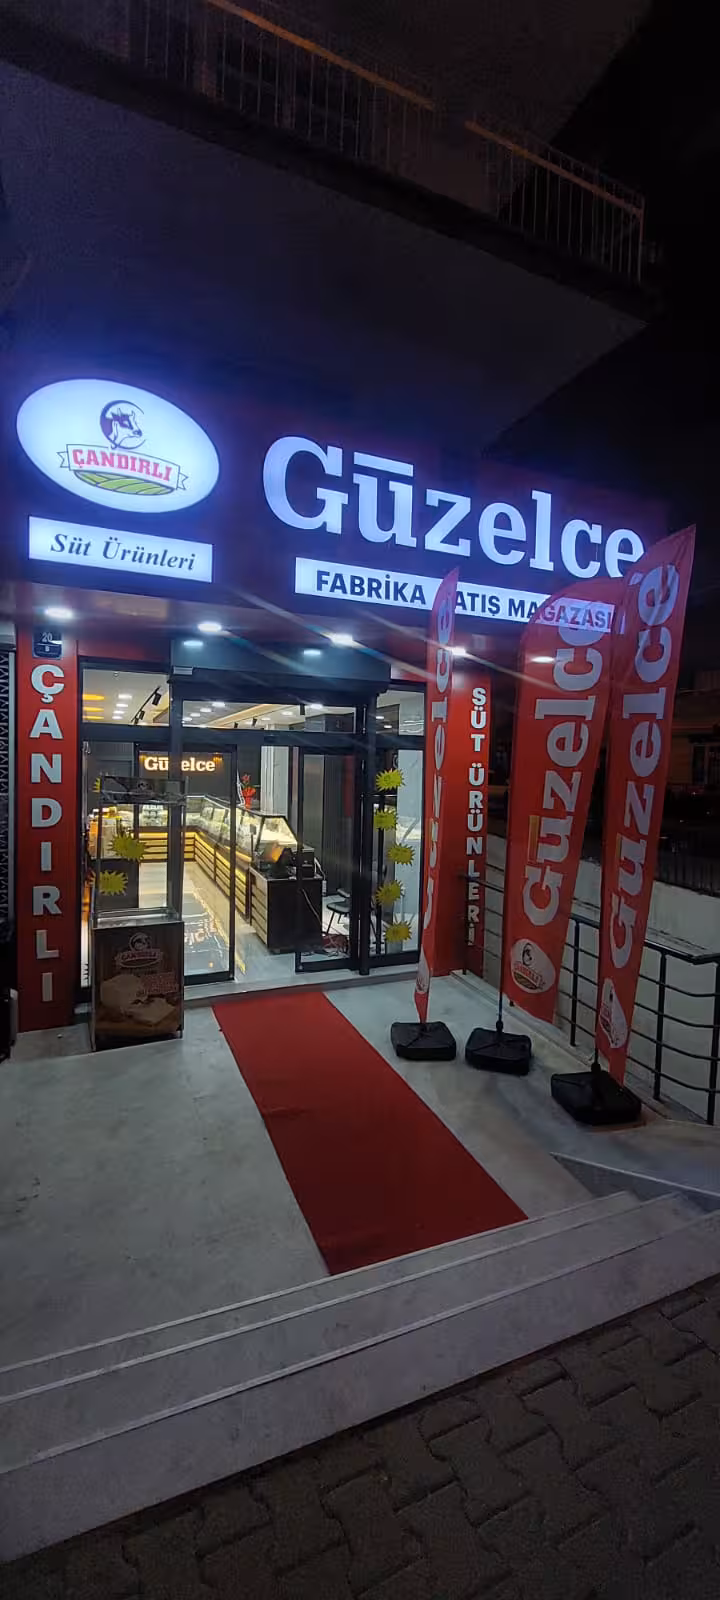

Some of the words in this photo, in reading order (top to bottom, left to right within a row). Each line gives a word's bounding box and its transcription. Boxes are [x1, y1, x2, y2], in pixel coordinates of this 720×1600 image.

[72, 448, 173, 482] ÇANDIRLI
[50, 533, 92, 556] Süt
[102, 536, 196, 571] Ürünleri
[316, 570, 427, 606] FABRİKA
[456, 590, 501, 617] ATIŞ
[470, 687, 487, 752] SÜT
[29, 664, 65, 1002] ÇANDIRLI
[466, 762, 485, 946] ÜRÜNLERİ
